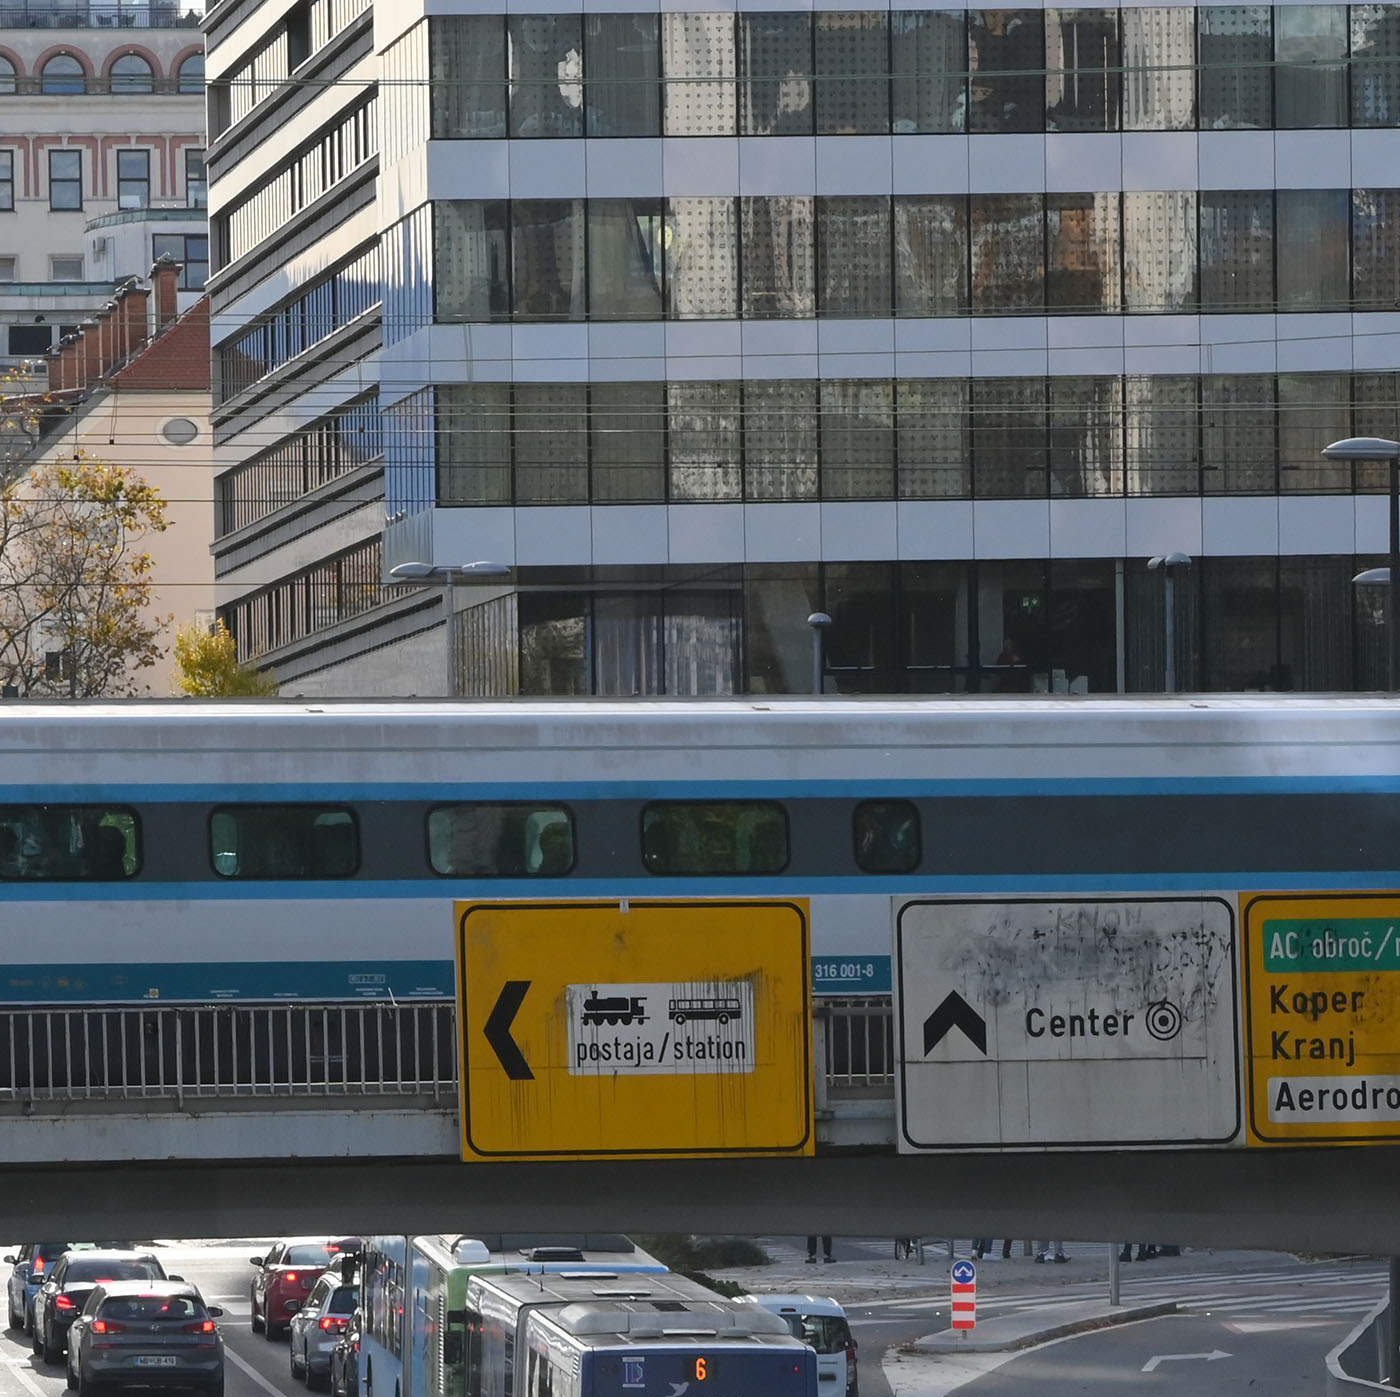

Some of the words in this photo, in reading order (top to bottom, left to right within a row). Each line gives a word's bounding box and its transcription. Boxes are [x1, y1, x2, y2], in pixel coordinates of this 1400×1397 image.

[1269, 931, 1299, 959] AC
[815, 964, 837, 978] 316
[840, 963, 874, 978] 001-8
[1270, 984, 1365, 1022] Koper
[1026, 1008, 1135, 1038] Center
[1271, 1030, 1355, 1067] Kranj
[695, 1357, 707, 1381] 6
